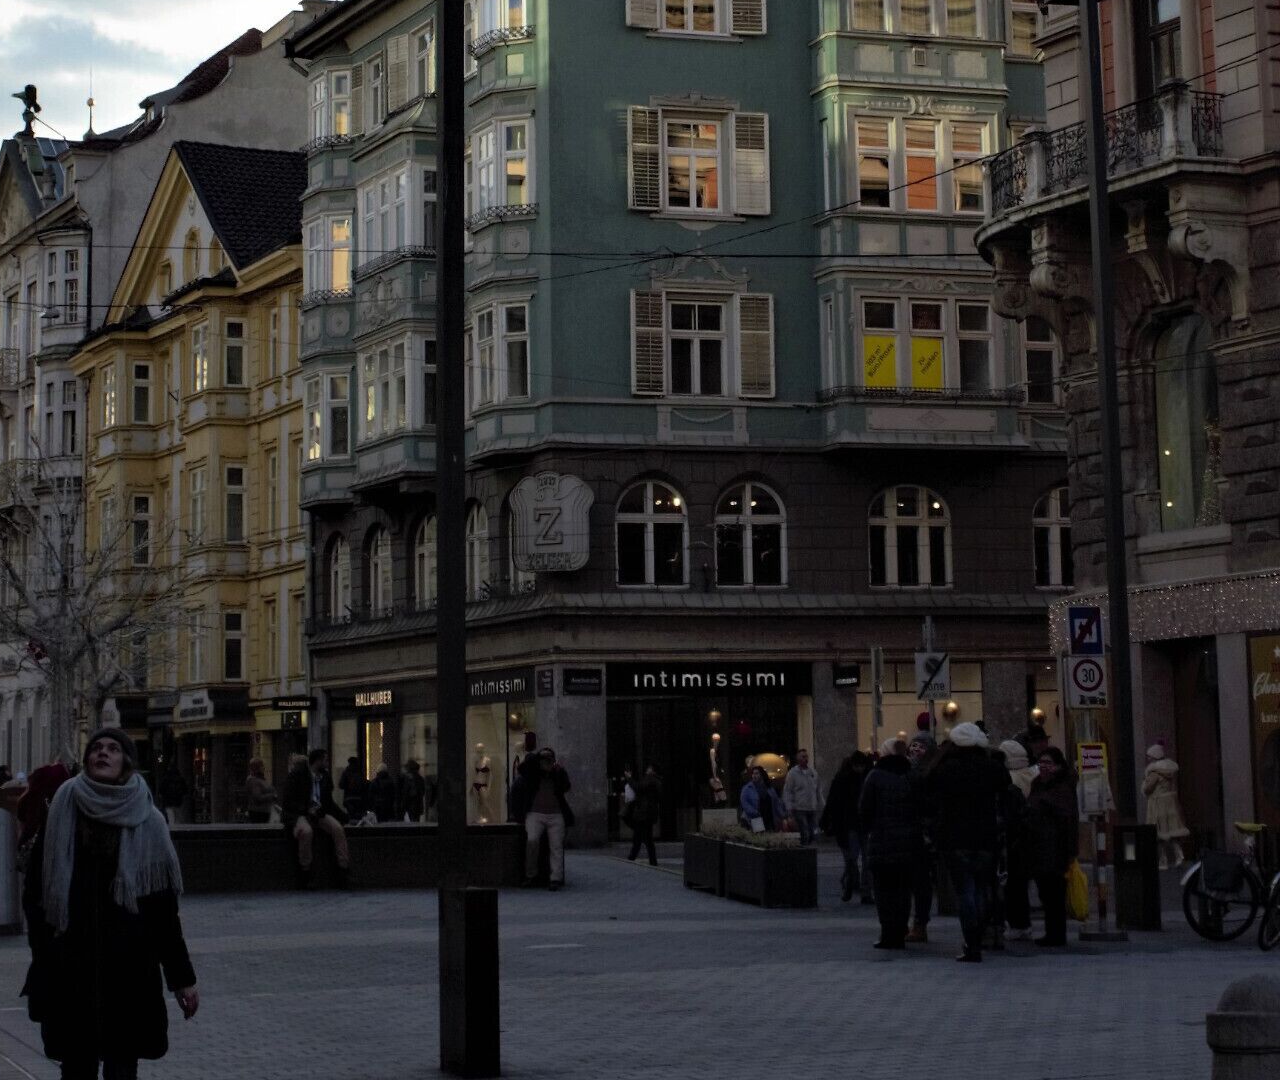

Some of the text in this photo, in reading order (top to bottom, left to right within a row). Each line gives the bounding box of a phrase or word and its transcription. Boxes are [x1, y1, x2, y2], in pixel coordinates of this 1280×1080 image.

[534, 507, 563, 546] Z
[633, 670, 786, 688] intimissimi
[1081, 668, 1095, 683] 30
[471, 678, 526, 696] intimissimi
[355, 690, 393, 707] HALLHUBER
